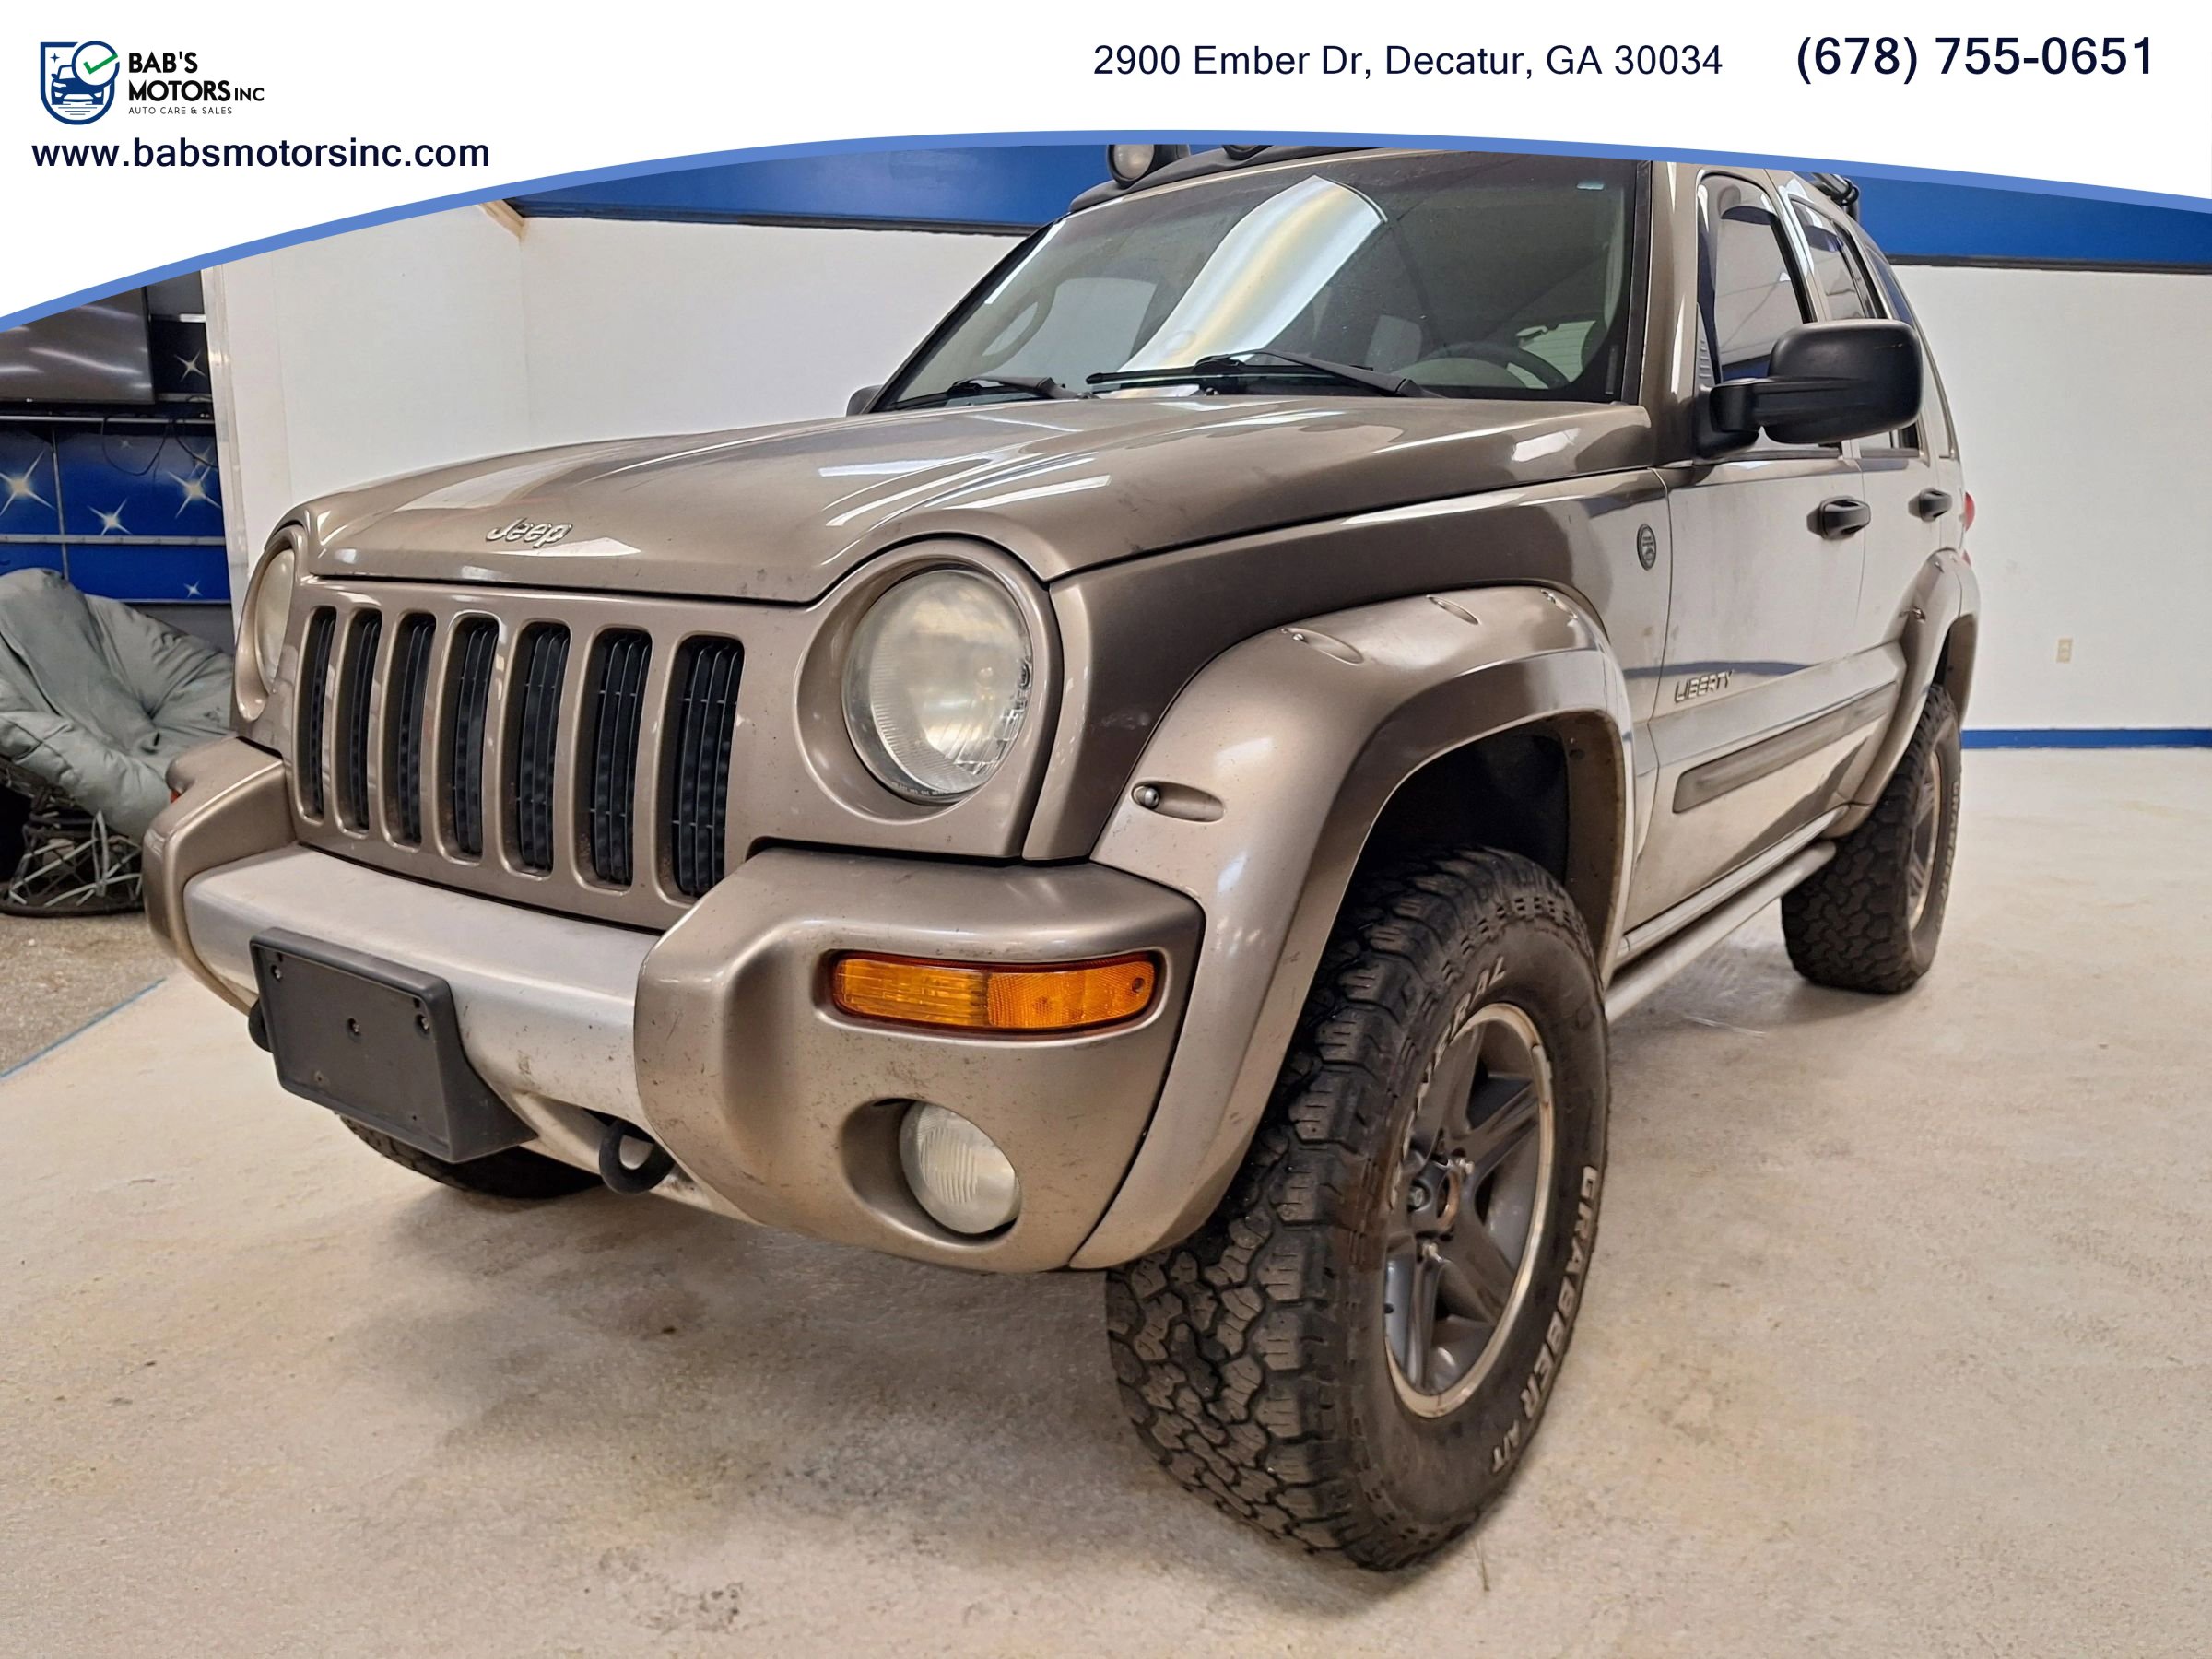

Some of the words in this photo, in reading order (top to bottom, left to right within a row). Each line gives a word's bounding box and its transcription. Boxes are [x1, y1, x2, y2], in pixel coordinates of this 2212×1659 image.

[485, 517, 573, 548] Jeep
[1674, 670, 1735, 703] LIBERTY
[1521, 1166, 1597, 1419] GRABBER
